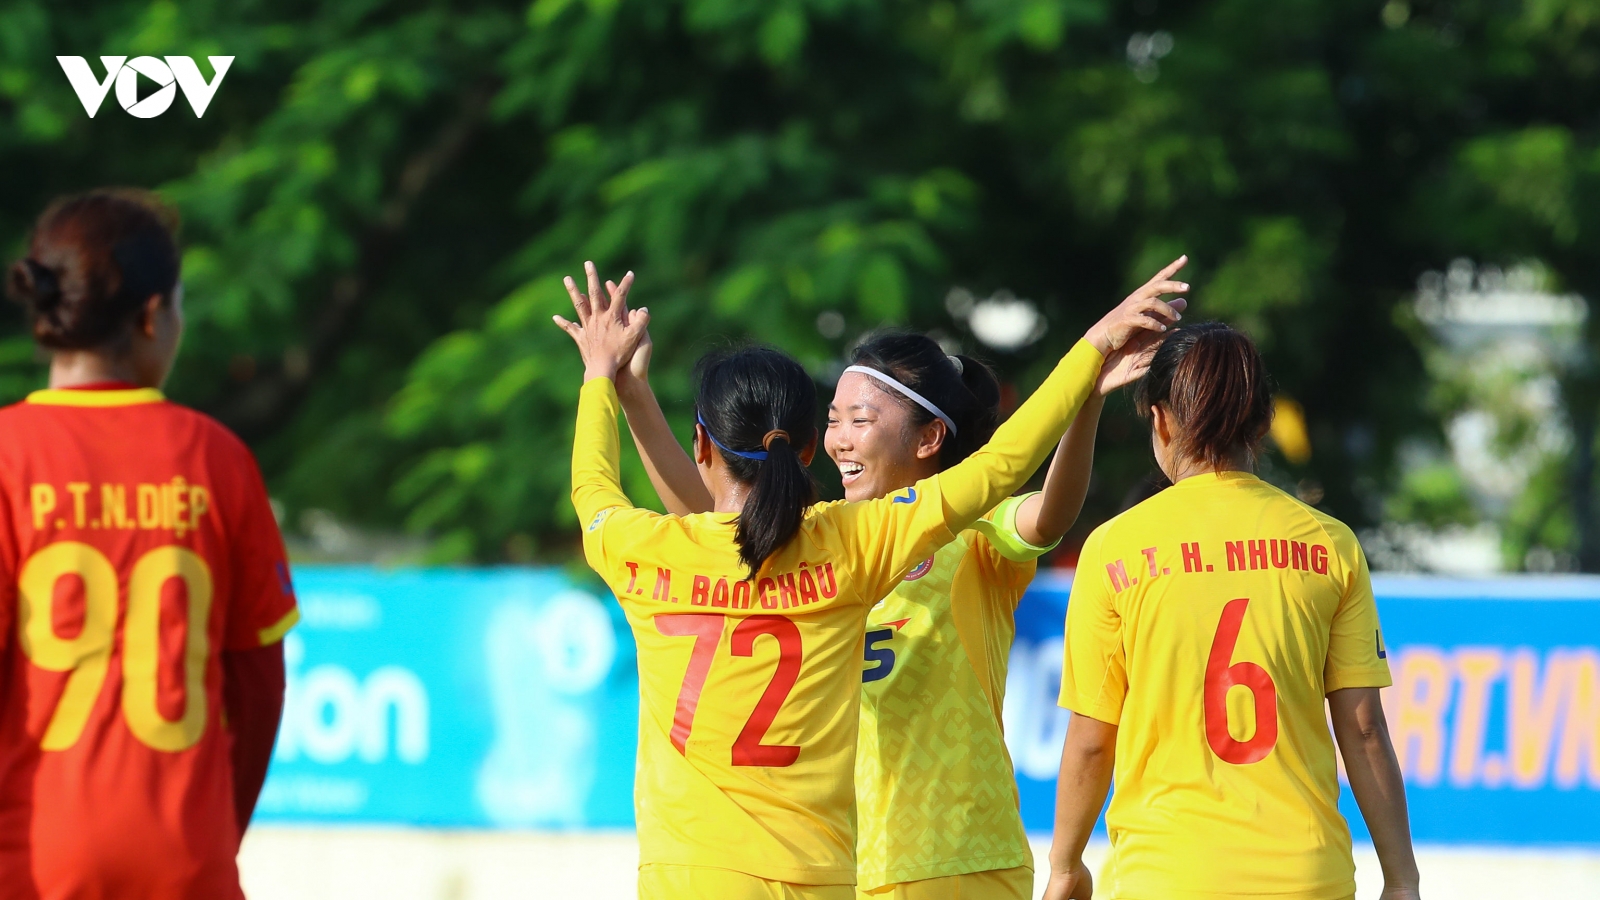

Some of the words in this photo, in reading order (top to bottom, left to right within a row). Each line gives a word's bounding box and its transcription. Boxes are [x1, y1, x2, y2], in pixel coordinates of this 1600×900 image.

[625, 561, 643, 595] T.
[652, 567, 678, 603] N.
[757, 561, 838, 609] CHÂU
[1105, 559, 1138, 593] N.
[1141, 546, 1170, 577] T.
[1180, 542, 1214, 573] H.
[1225, 539, 1329, 576] NHUNG
[18, 541, 213, 753] 90
[654, 613, 802, 767] 72
[1203, 598, 1277, 765] 6
